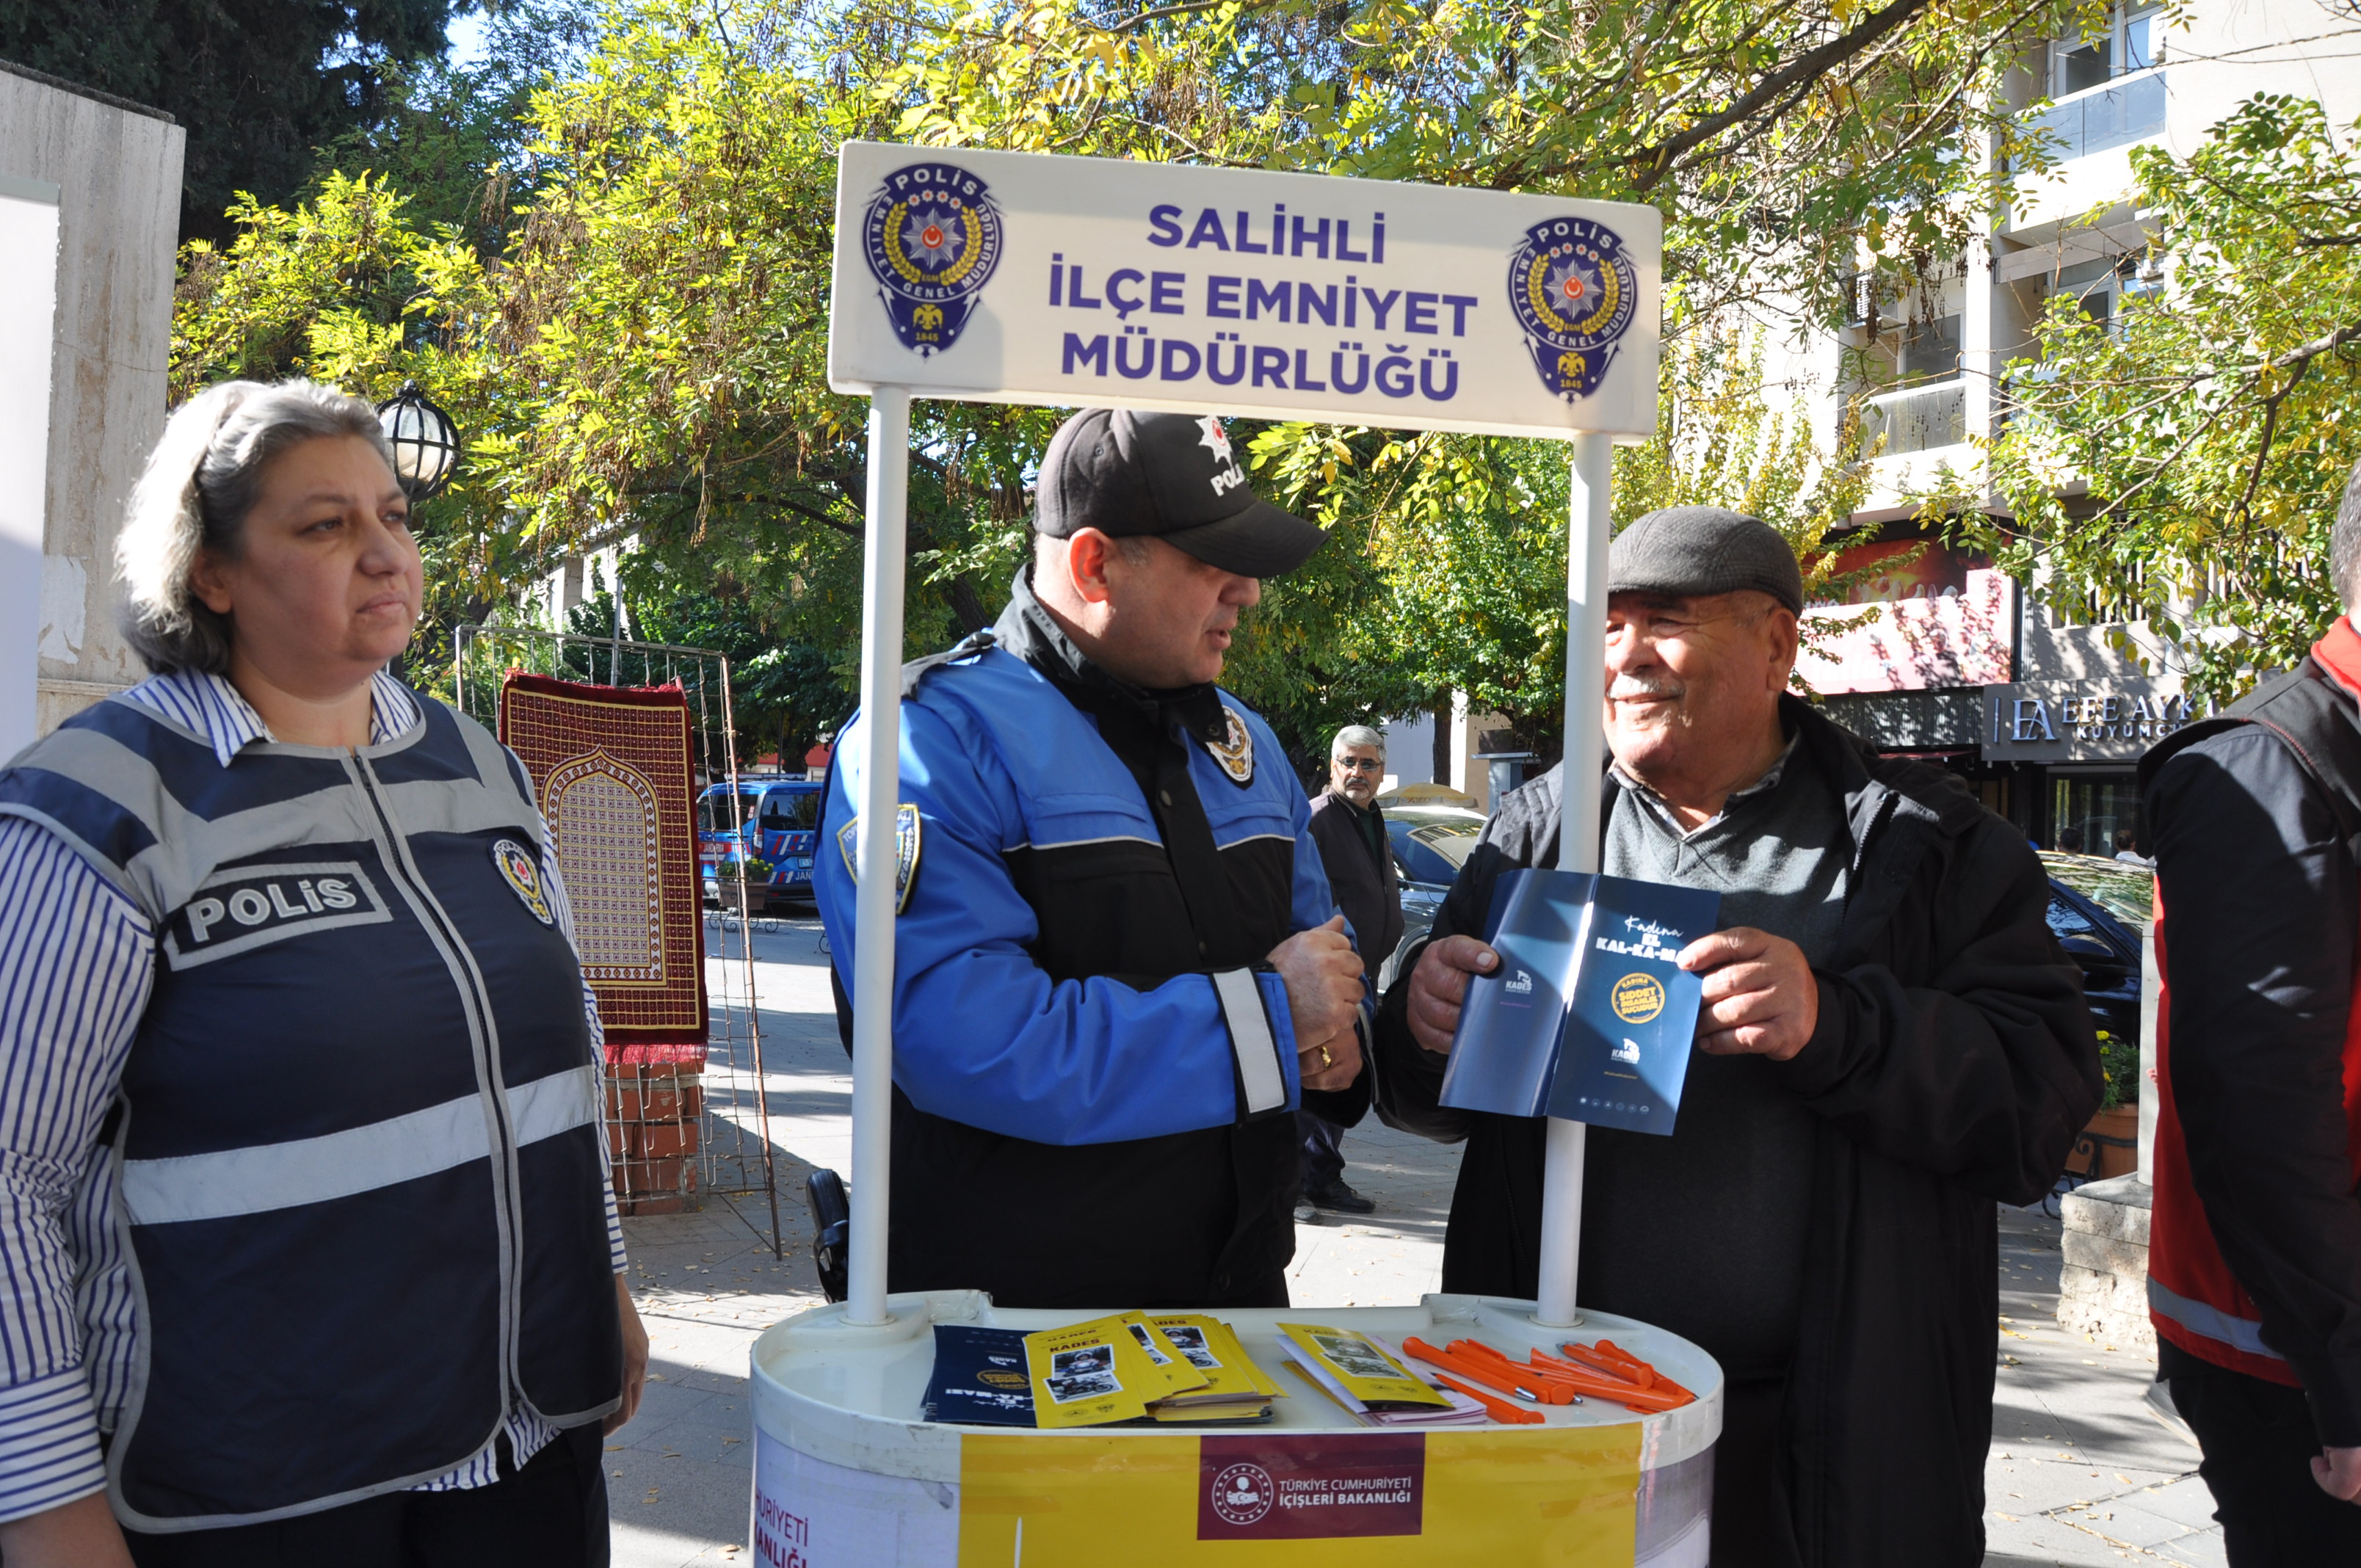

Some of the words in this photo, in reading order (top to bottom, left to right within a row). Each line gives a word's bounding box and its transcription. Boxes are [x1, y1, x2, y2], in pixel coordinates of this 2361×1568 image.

[894, 168, 978, 196] POLİS
[1147, 203, 1385, 264] SALİHLİ
[1537, 222, 1614, 250] POLİS
[903, 282, 956, 298] GENEL
[1049, 253, 1186, 321] İLÇE
[1206, 275, 1479, 337] EMNİYET
[915, 331, 939, 342] 1845
[1547, 330, 1597, 347] GENEL
[1062, 325, 1459, 402] MÜDÜRLÜĞÜ
[1560, 378, 1583, 389] 1845
[2061, 697, 2119, 723] EFE
[1642, 932, 1661, 948] EL
[1505, 980, 1532, 991] KADES
[1049, 1338, 1100, 1353] KADES
[1279, 1478, 1328, 1492] TÜRKİYE
[1330, 1476, 1412, 1491] CUMHURİYETİ
[1279, 1492, 1334, 1509] İÇİŞLERİ
[1338, 1489, 1411, 1505] BAKANLIĞI
